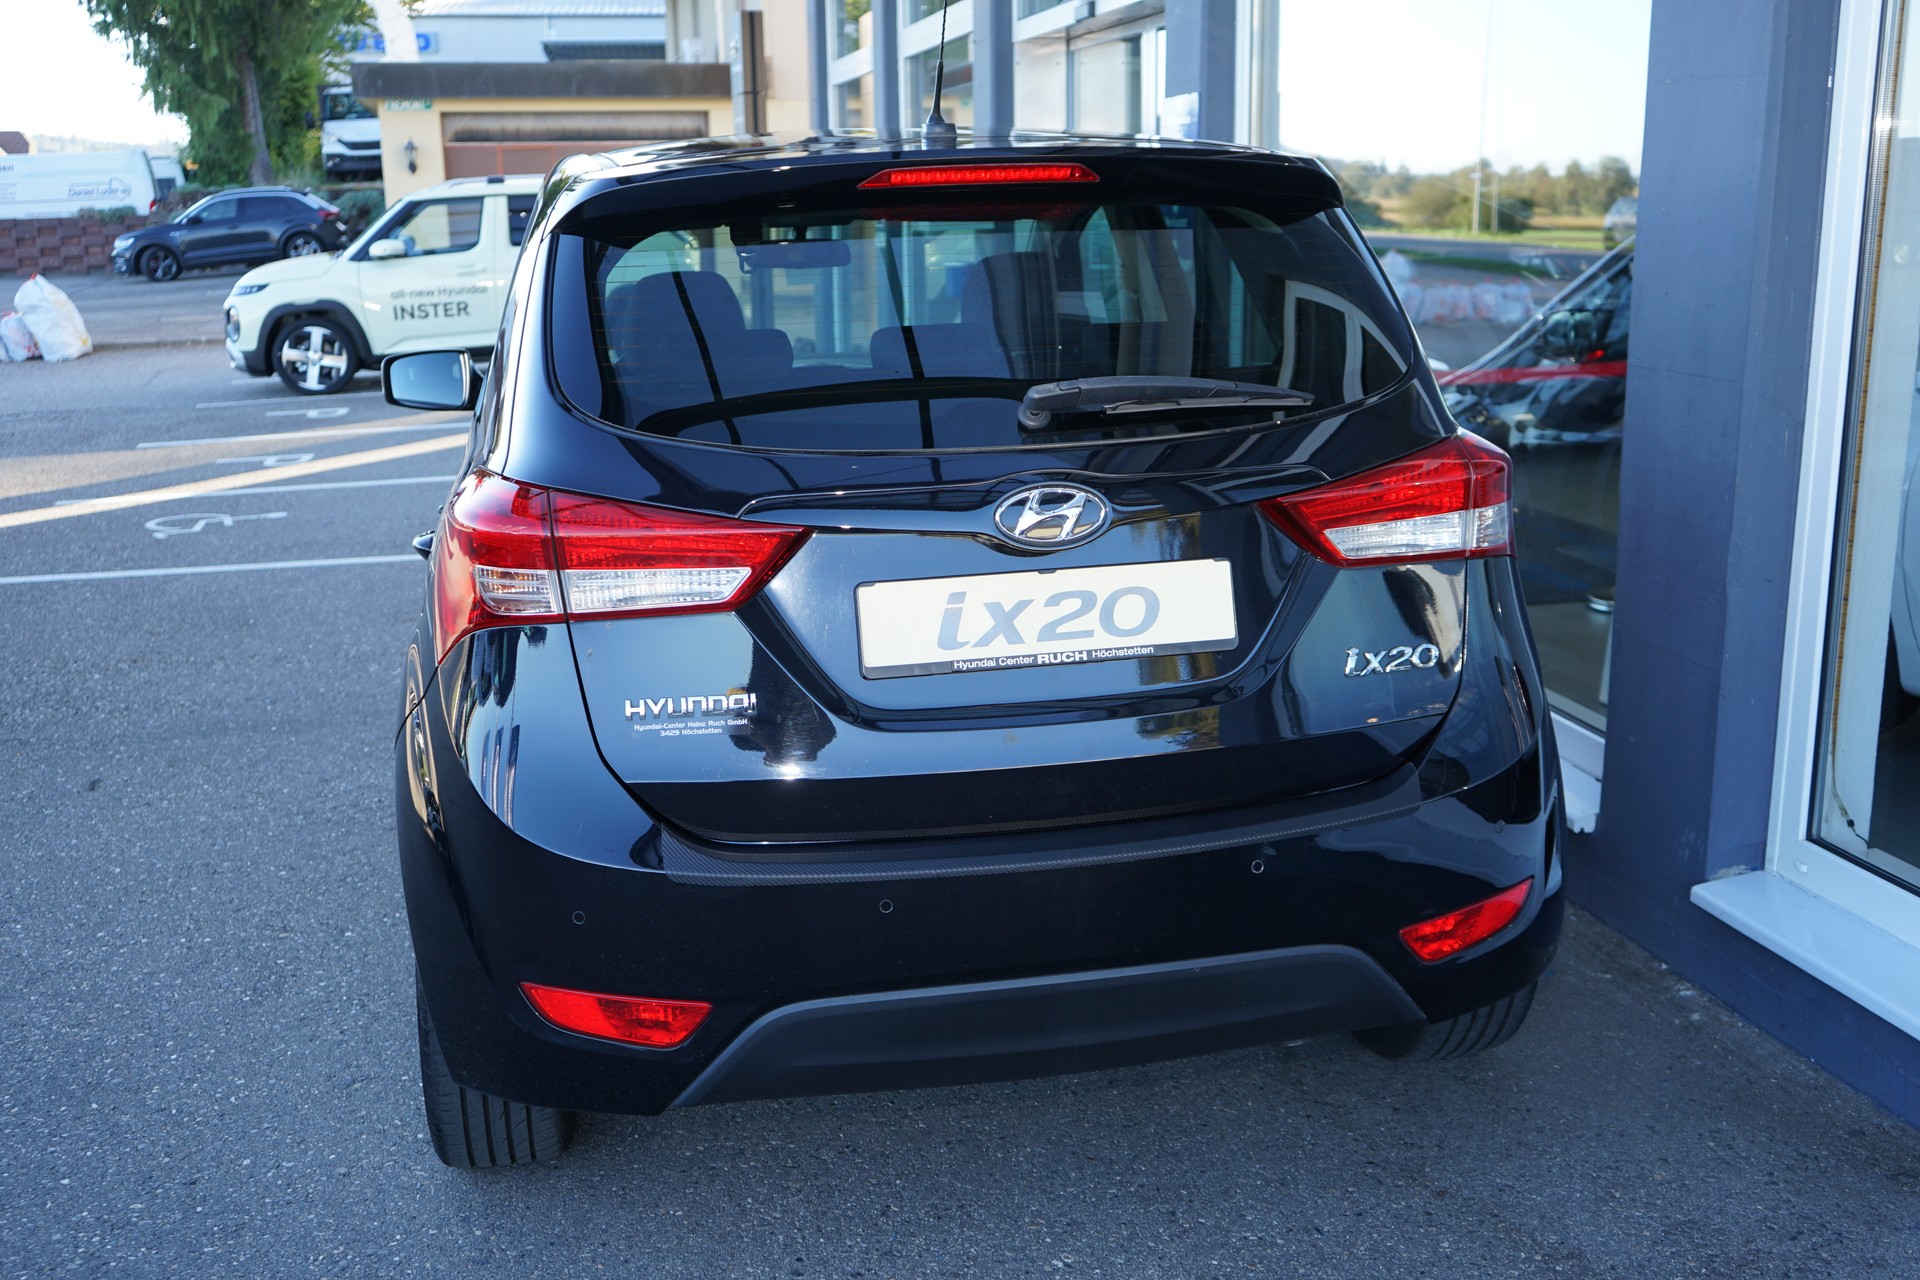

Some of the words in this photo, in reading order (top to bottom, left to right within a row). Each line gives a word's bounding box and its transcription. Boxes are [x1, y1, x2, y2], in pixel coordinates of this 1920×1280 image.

[393, 301, 470, 321] INSTER
[936, 586, 1161, 651] ix20
[953, 658, 996, 671] Hyundai
[998, 655, 1035, 666] Center
[1037, 651, 1088, 664] RUCH
[1091, 646, 1154, 658] Höchstetten
[1344, 643, 1440, 677] ix20
[624, 693, 757, 720] HYUNDAI
[634, 721, 686, 731] Hyundai-Center
[682, 727, 722, 736] Höchstetten
